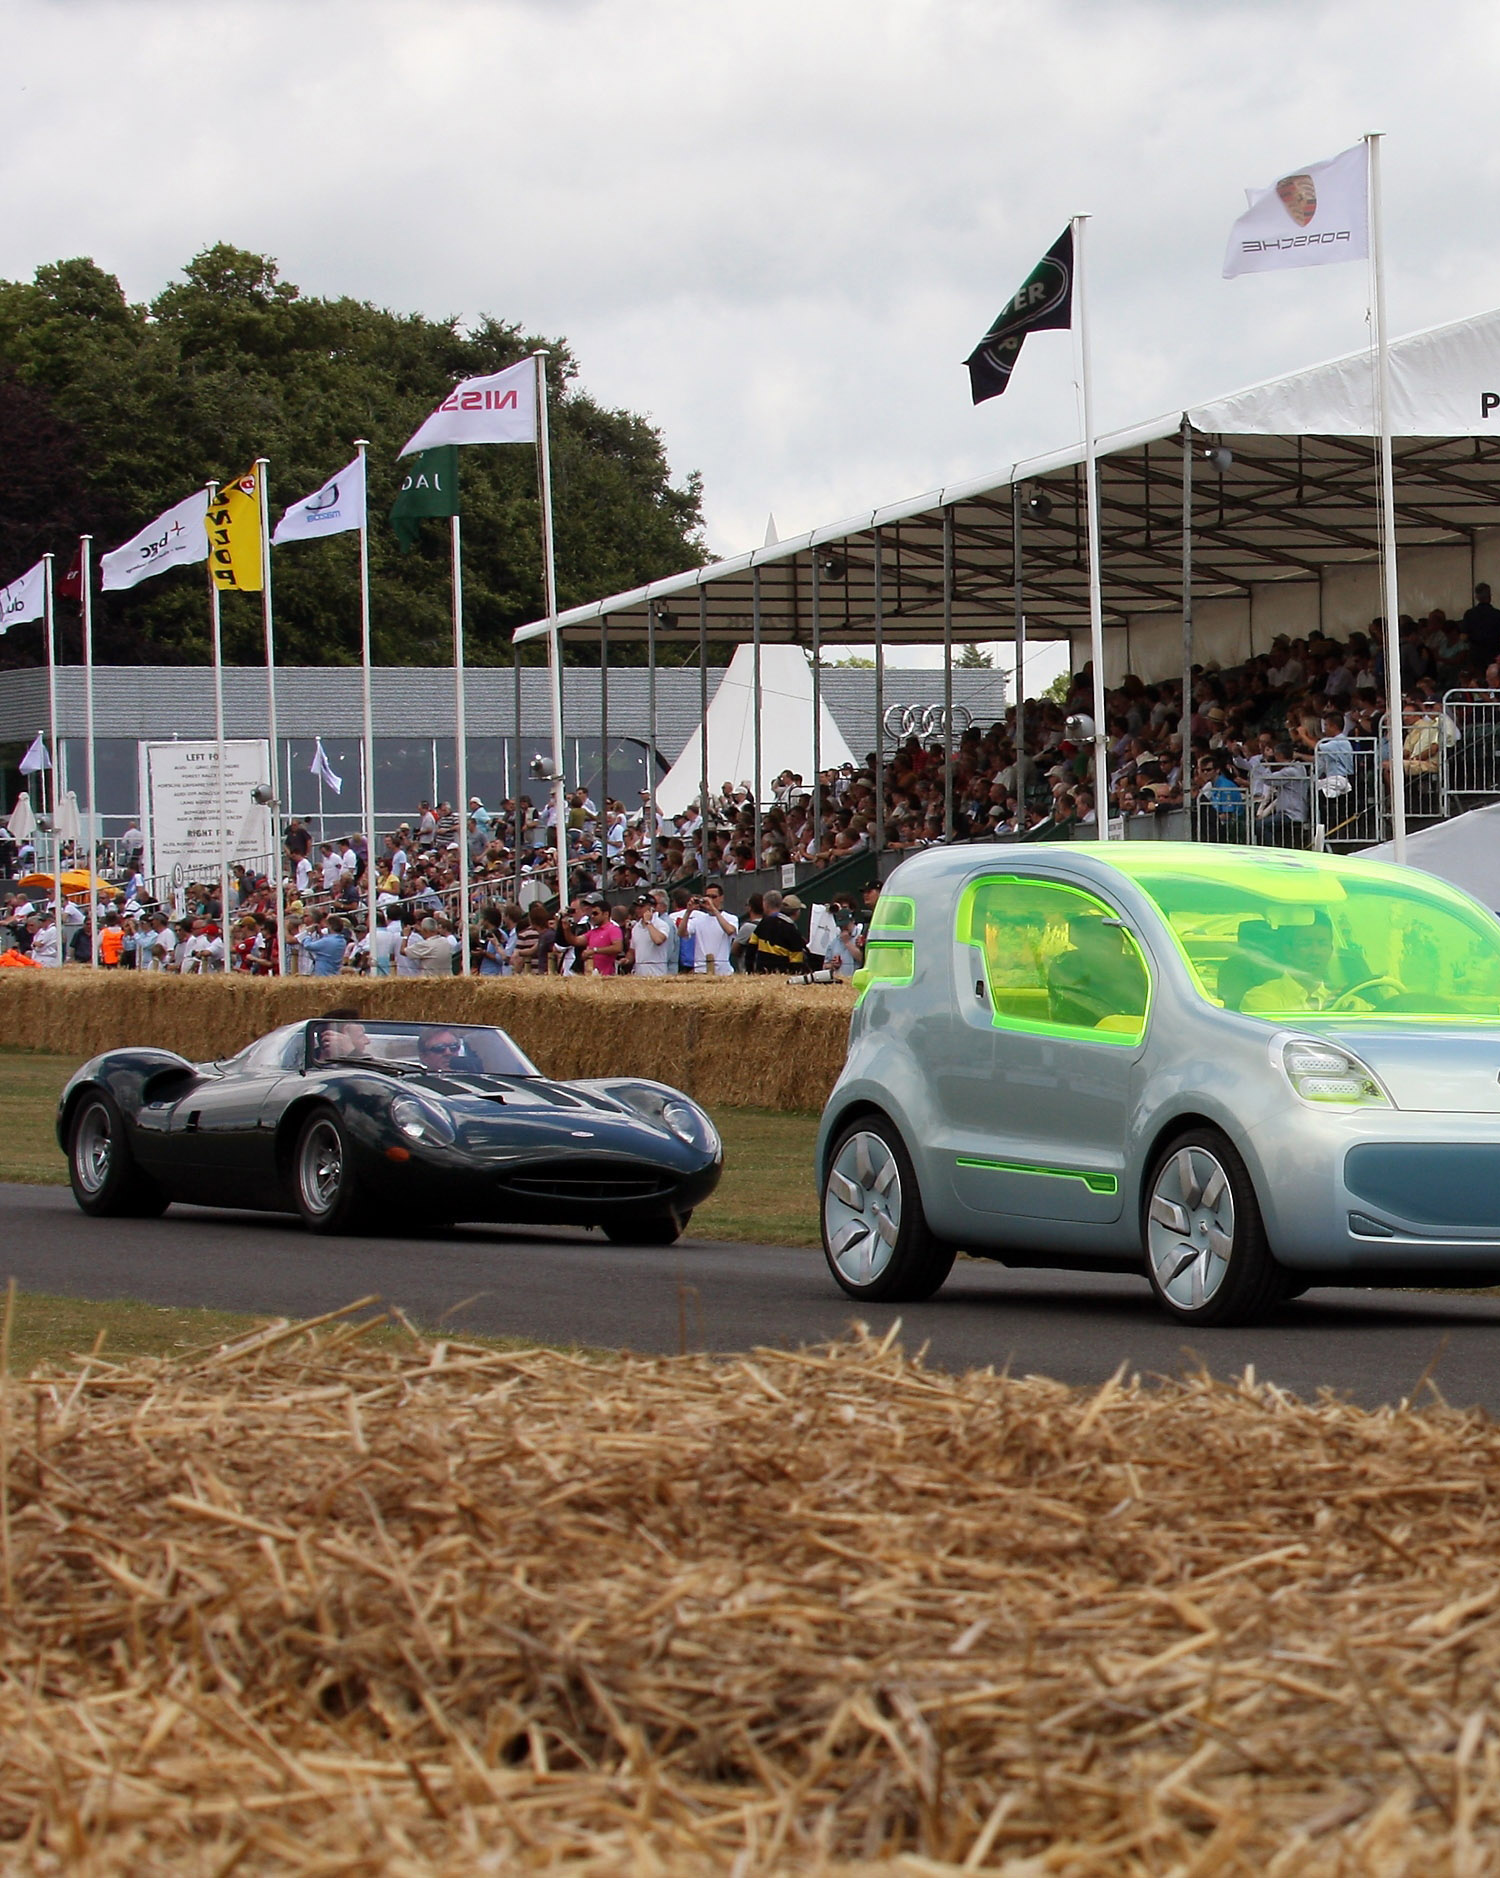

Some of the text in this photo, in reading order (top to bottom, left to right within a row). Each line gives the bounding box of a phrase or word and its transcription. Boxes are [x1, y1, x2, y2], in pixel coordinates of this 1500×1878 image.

[186, 753, 205, 761] LEFT
[187, 829, 235, 837] RIGHT FR:
